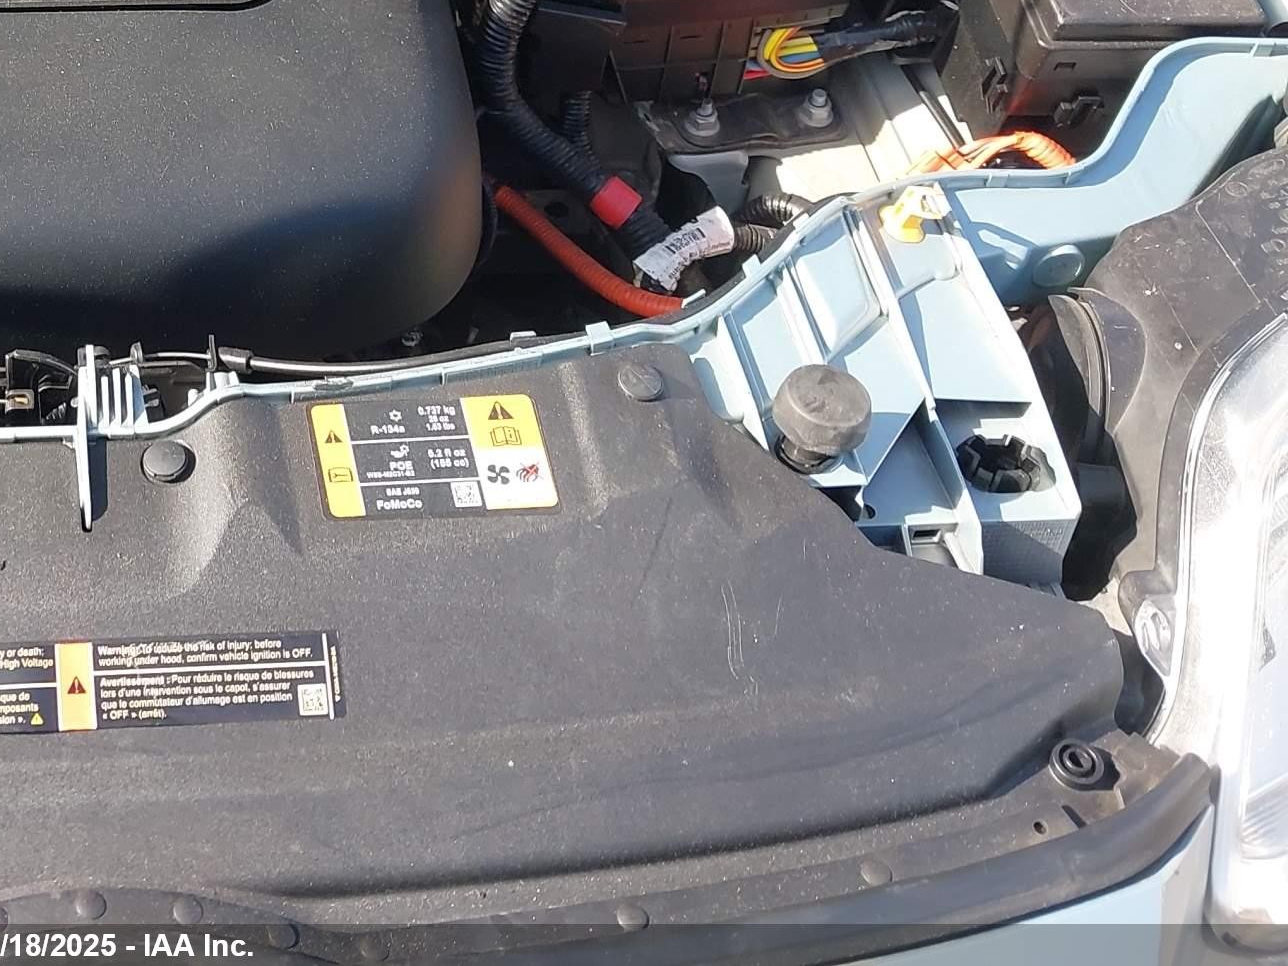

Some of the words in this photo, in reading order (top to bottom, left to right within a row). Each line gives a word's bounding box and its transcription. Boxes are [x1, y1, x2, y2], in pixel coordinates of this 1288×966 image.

[389, 460, 414, 471] POE
[376, 498, 423, 511] FoMoCo
[216, 640, 226, 651] of
[254, 639, 282, 650] before
[6, 649, 16, 657] or
[98, 656, 133, 667] working
[134, 655, 159, 665] under
[186, 652, 218, 663] confirm
[218, 650, 249, 662] vehicle
[250, 649, 282, 662] ignition
[292, 648, 313, 658] OFF.
[0, 659, 20, 671] High
[21, 658, 54, 669] Voltage
[171, 674, 191, 685] Pour
[233, 671, 260, 683] risque
[261, 670, 272, 680] de
[274, 669, 314, 680] blessures
[18, 691, 30, 702] de
[100, 688, 117, 699] lors
[143, 686, 192, 698] intervention
[193, 684, 214, 695] sous
[101, 700, 118, 711] que
[129, 697, 184, 708] commutateur
[232, 693, 246, 704] est
[247, 694, 259, 704] en
[260, 692, 293, 705] position
[109, 709, 129, 720] OFF
